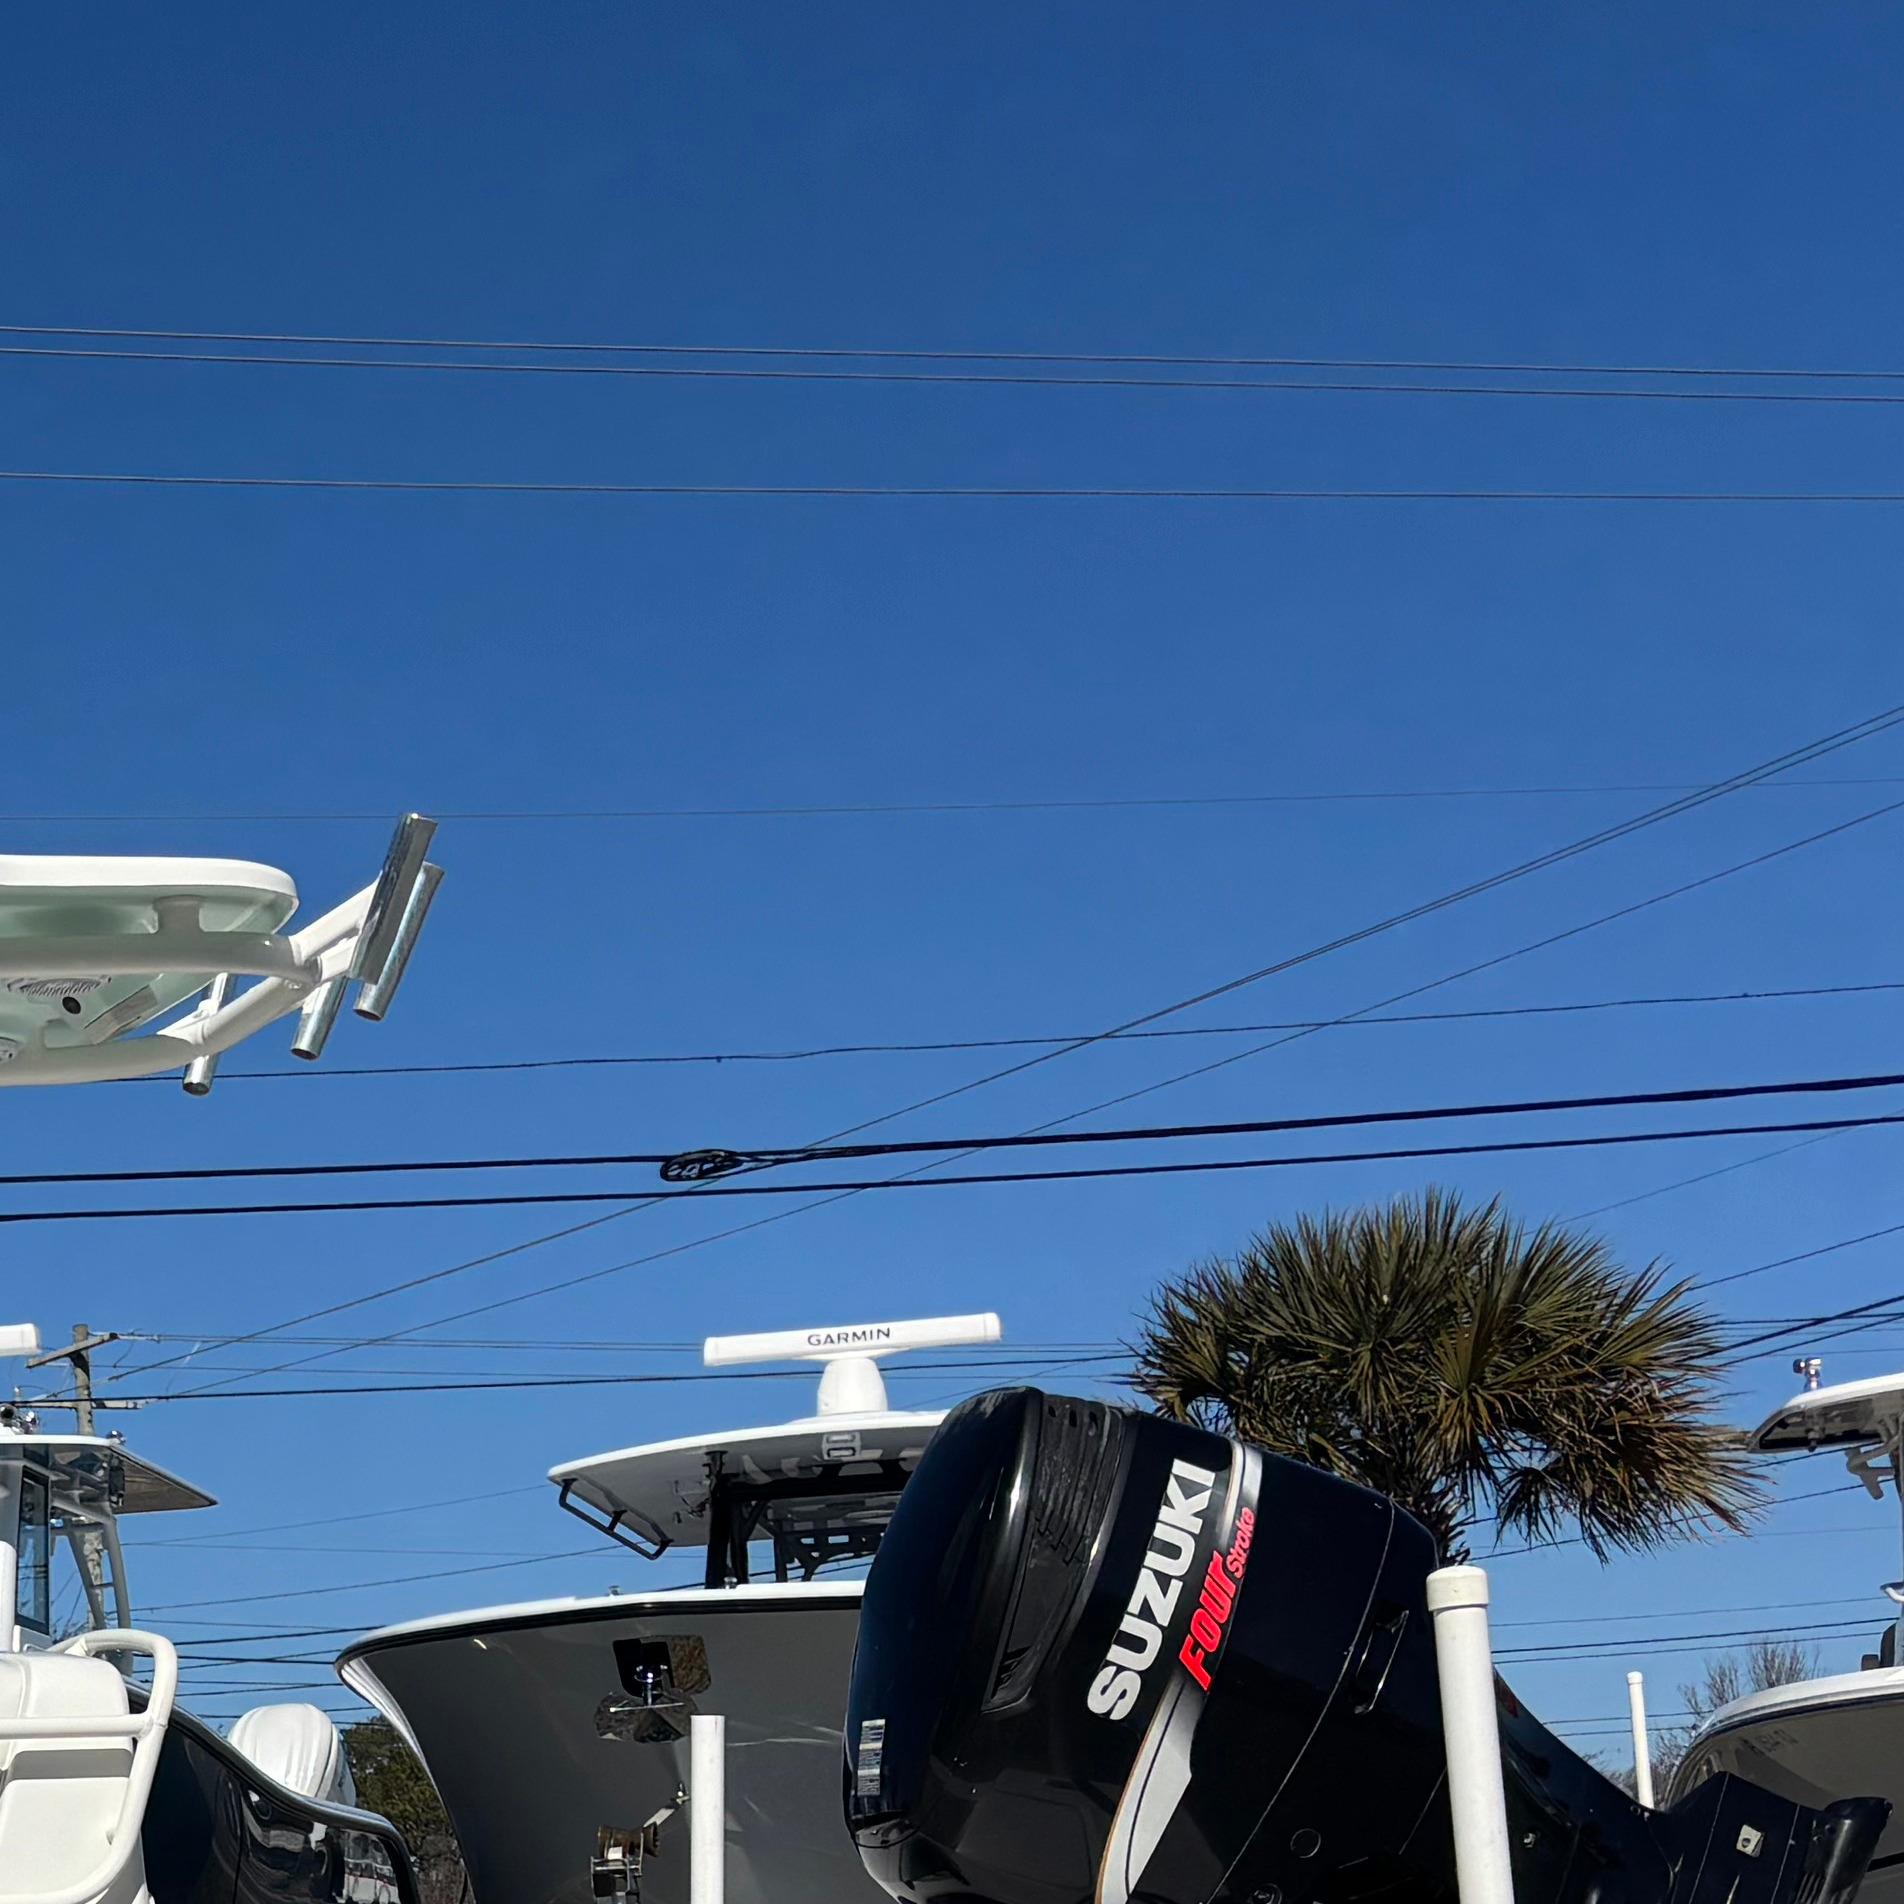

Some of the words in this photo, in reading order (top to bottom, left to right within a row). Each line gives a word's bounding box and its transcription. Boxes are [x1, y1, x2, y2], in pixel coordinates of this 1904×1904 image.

[807, 1327, 890, 1346] GARMIN
[1226, 1507, 1255, 1579] Stroke
[1087, 1458, 1217, 1721] SUZUKI
